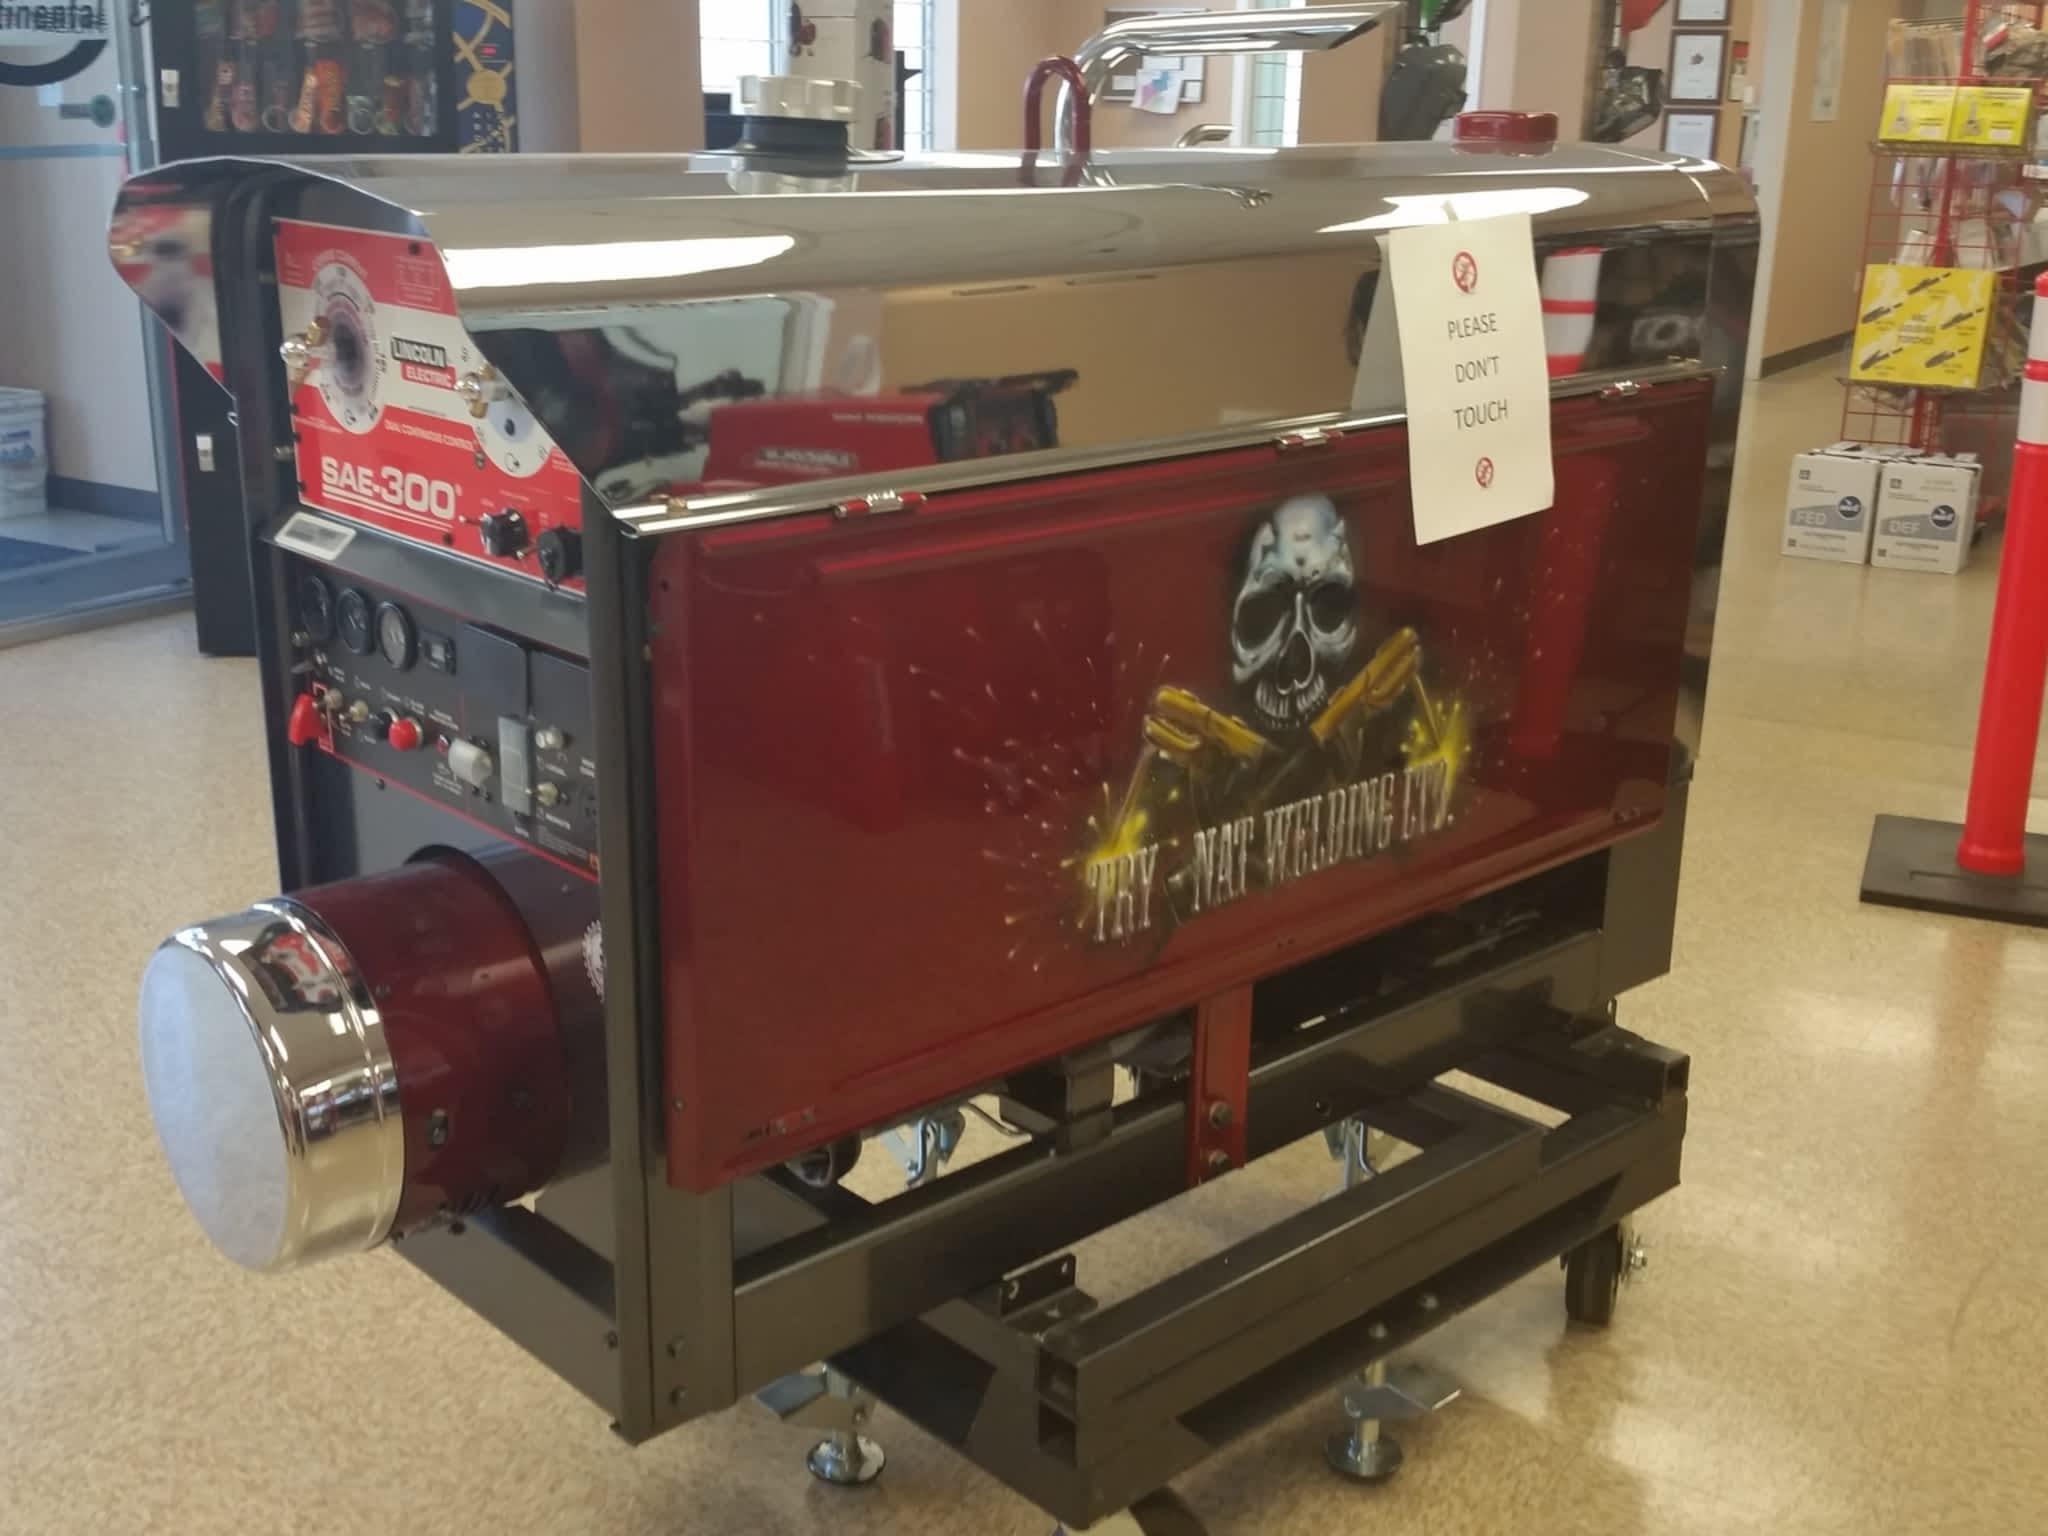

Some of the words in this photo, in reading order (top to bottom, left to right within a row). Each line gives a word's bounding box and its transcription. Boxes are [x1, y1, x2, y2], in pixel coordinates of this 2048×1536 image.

[1448, 313, 1498, 340] PLEASE
[392, 338, 446, 368] LINCOLN
[405, 363, 454, 389] ELECTRIC
[1455, 356, 1500, 384] DON'T
[1453, 399, 1509, 430] TOUCH
[321, 455, 456, 521] SAE-300
[1264, 772, 1395, 882] WELDING
